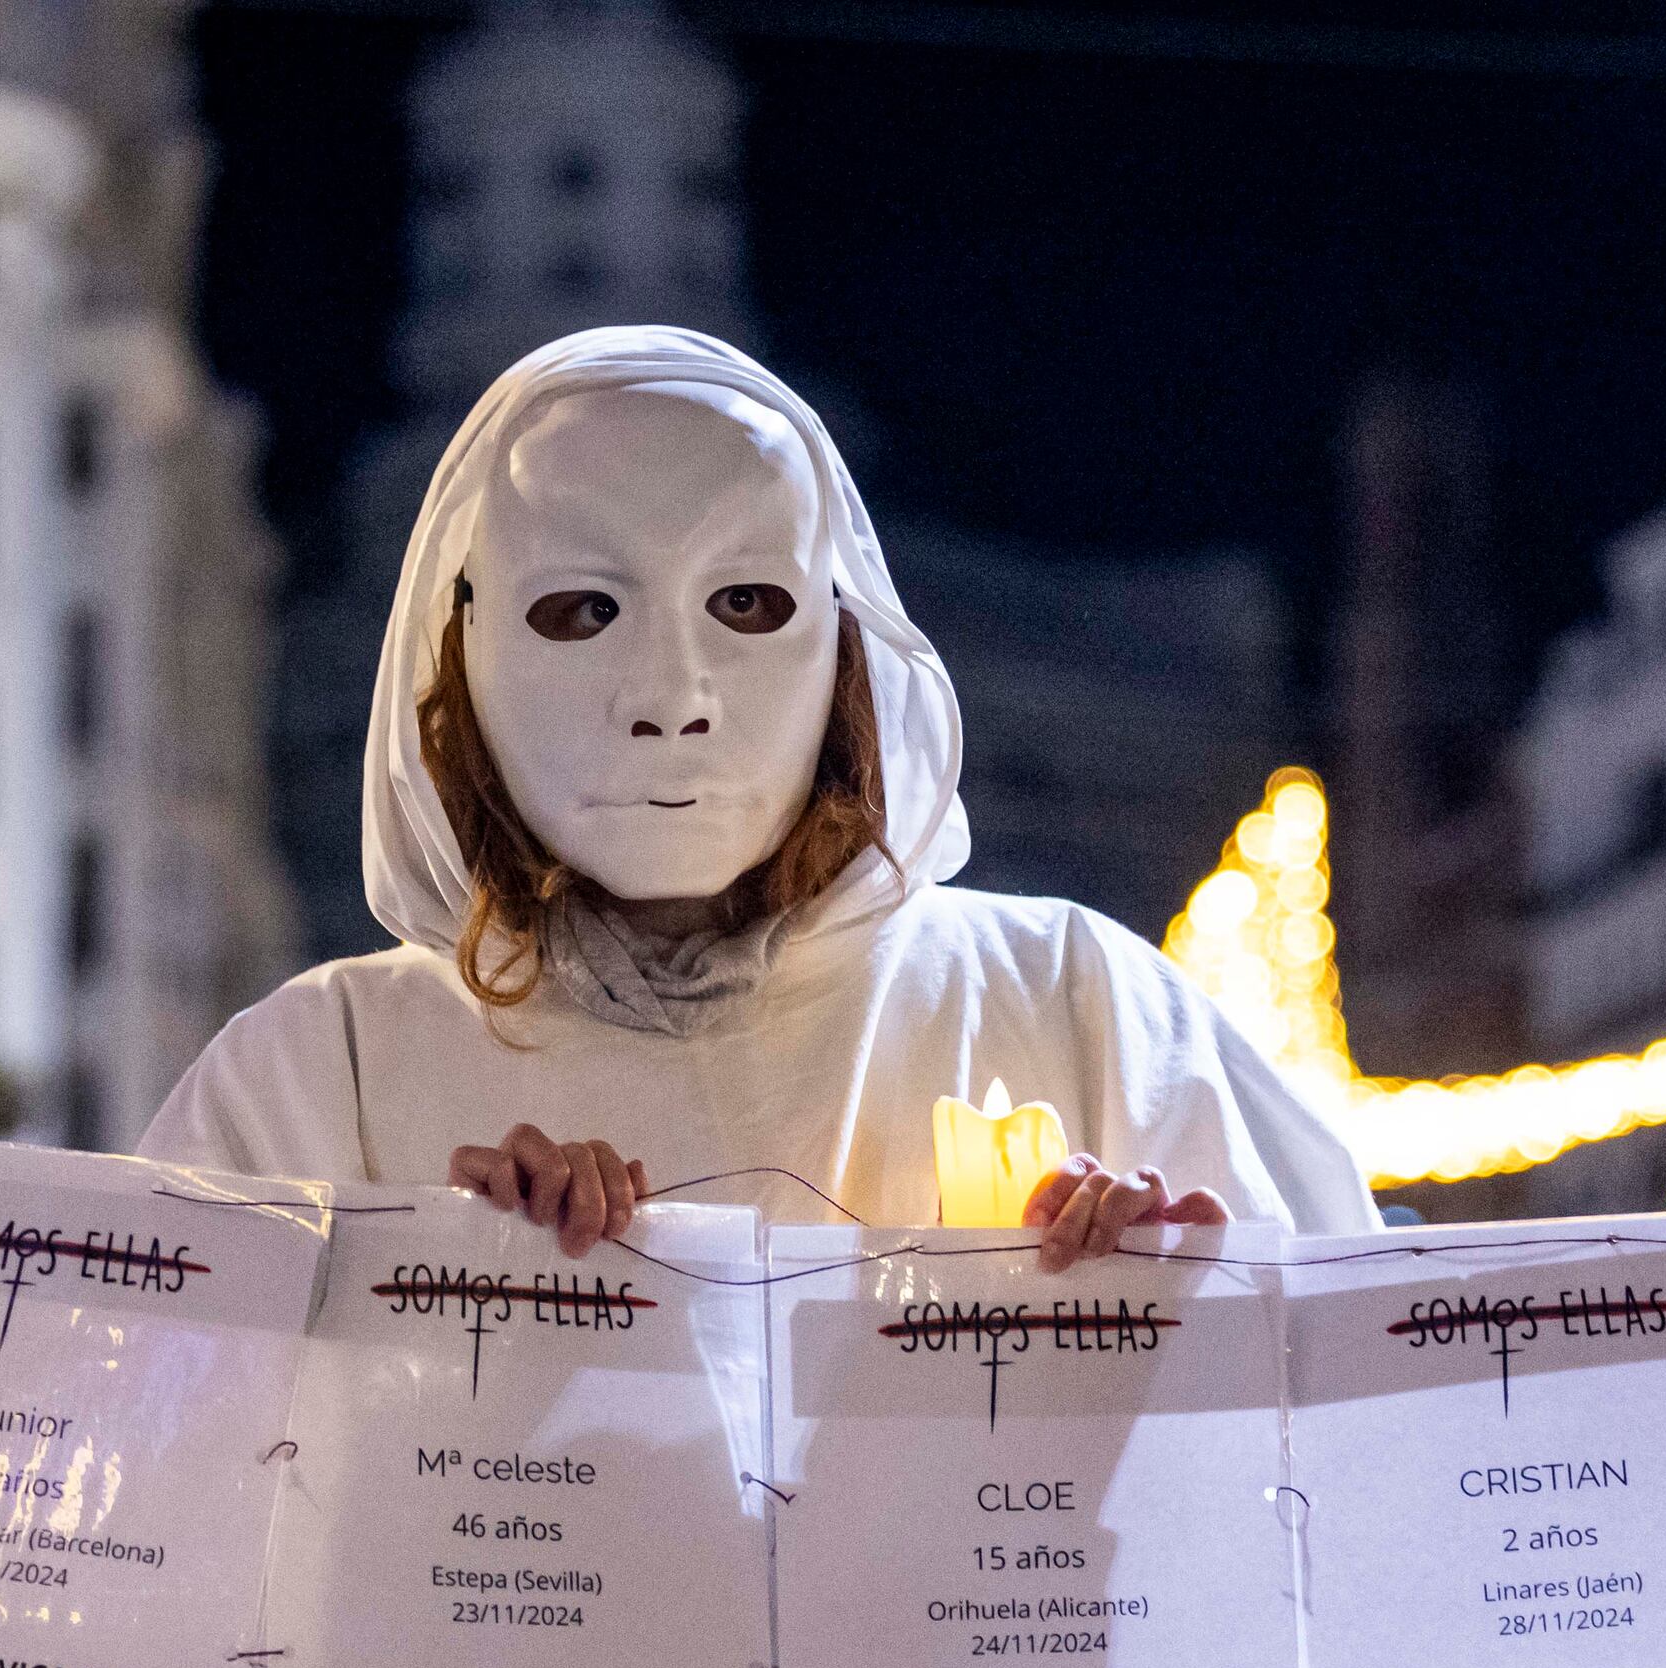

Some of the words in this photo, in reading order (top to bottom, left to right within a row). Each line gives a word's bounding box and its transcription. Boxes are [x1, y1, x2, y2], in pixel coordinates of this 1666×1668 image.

[79, 1230, 191, 1295] ELLAS
[900, 1303, 1030, 1354] SOMOS
[1053, 1301, 1160, 1354] ELLAS
[472, 1453, 597, 1486] celeste
[1458, 1459, 1630, 1499] CRISTIAN
[975, 1480, 1076, 1513] CLOE
[1503, 1527, 1519, 1554] 2
[1528, 1524, 1599, 1551] años
[430, 1564, 508, 1593] Estepa
[514, 1569, 604, 1596] (Sevilla)
[1481, 1581, 1570, 1604] Linares
[1576, 1572, 1645, 1600] (Jaén)
[451, 1601, 585, 1627] 23/11/2024
[926, 1599, 1032, 1623] Orihuela
[1037, 1596, 1150, 1620] (Alicante)
[1498, 1606, 1635, 1637] 28/11/2024
[971, 1630, 1109, 1657] 24/11/2024
